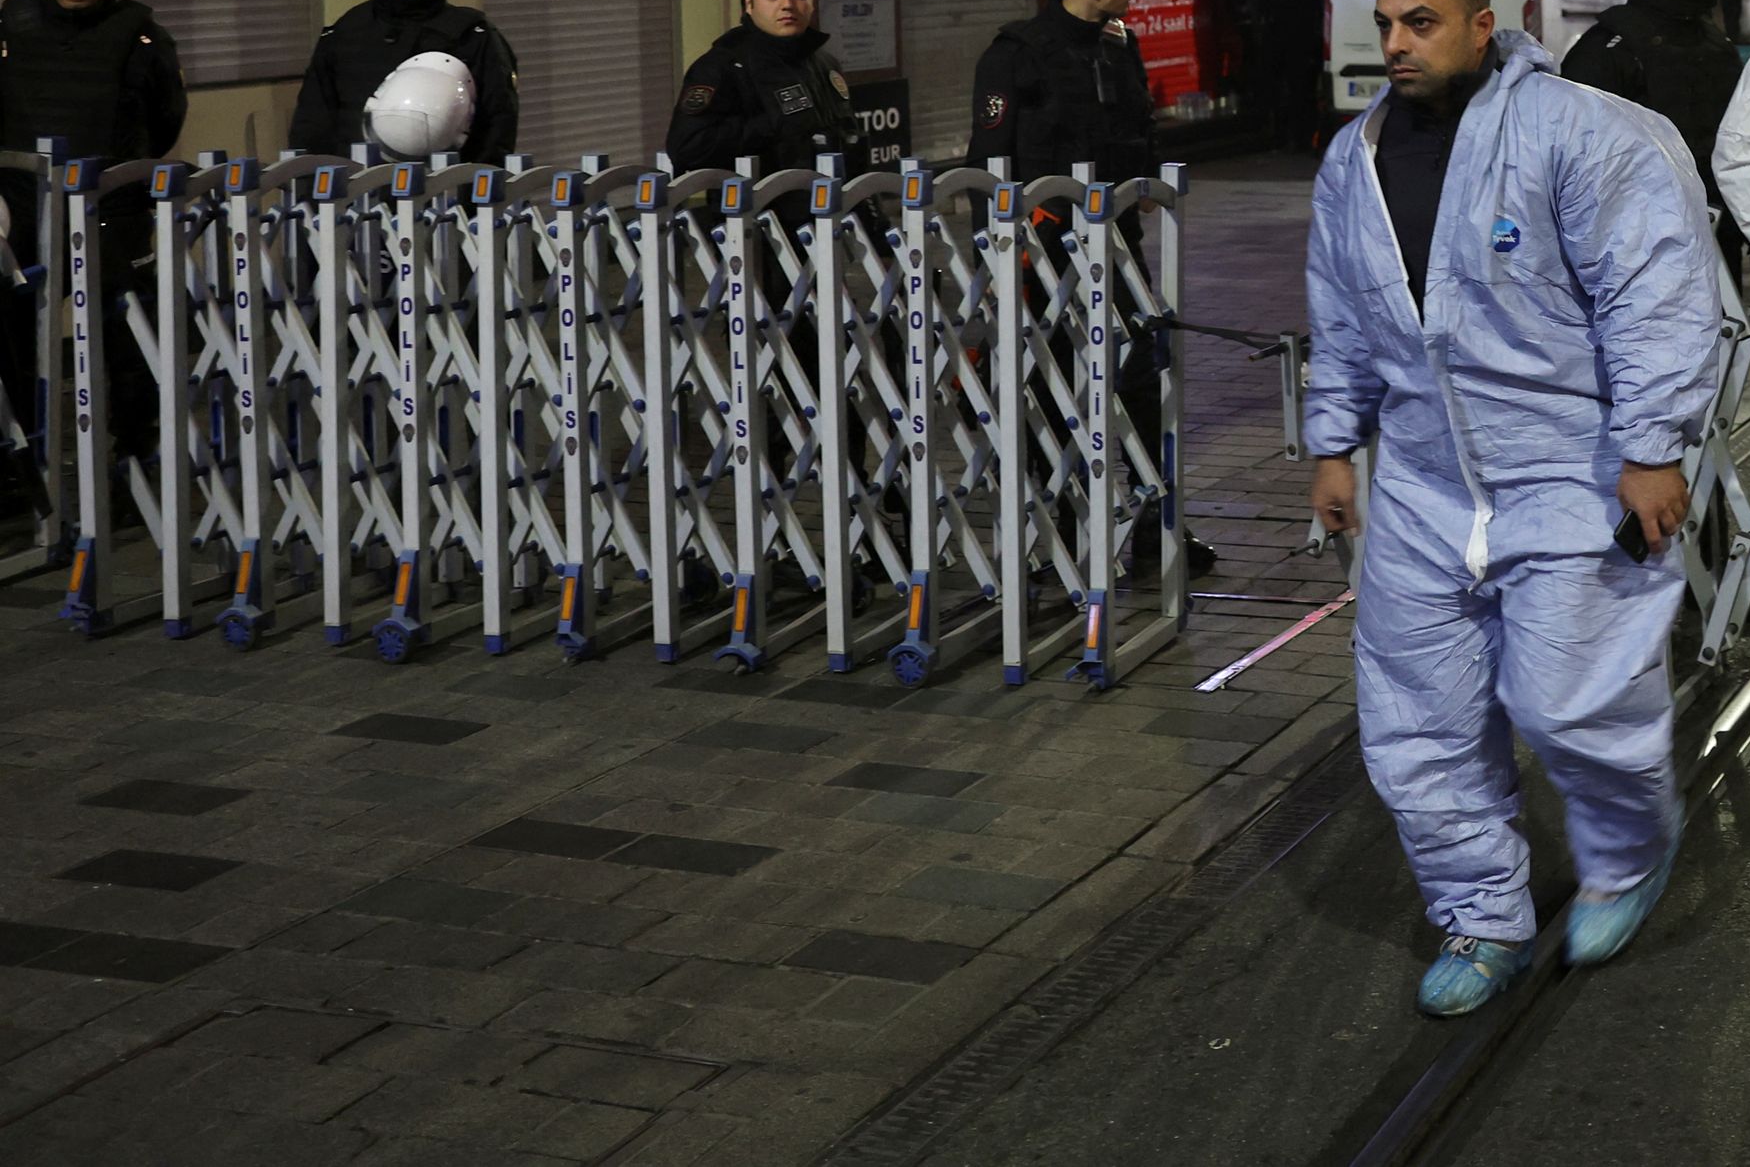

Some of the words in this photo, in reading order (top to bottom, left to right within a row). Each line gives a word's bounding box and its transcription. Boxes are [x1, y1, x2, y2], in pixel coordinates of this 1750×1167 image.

[1147, 16, 1163, 35] 24
[72, 257, 89, 406] POLİS
[236, 257, 252, 409] POLİS
[400, 263, 415, 416] POLİS
[560, 274, 577, 429] POLİS
[731, 283, 747, 439] POLİS
[910, 275, 924, 434] POLİS
[1090, 291, 1103, 452] POLİS
